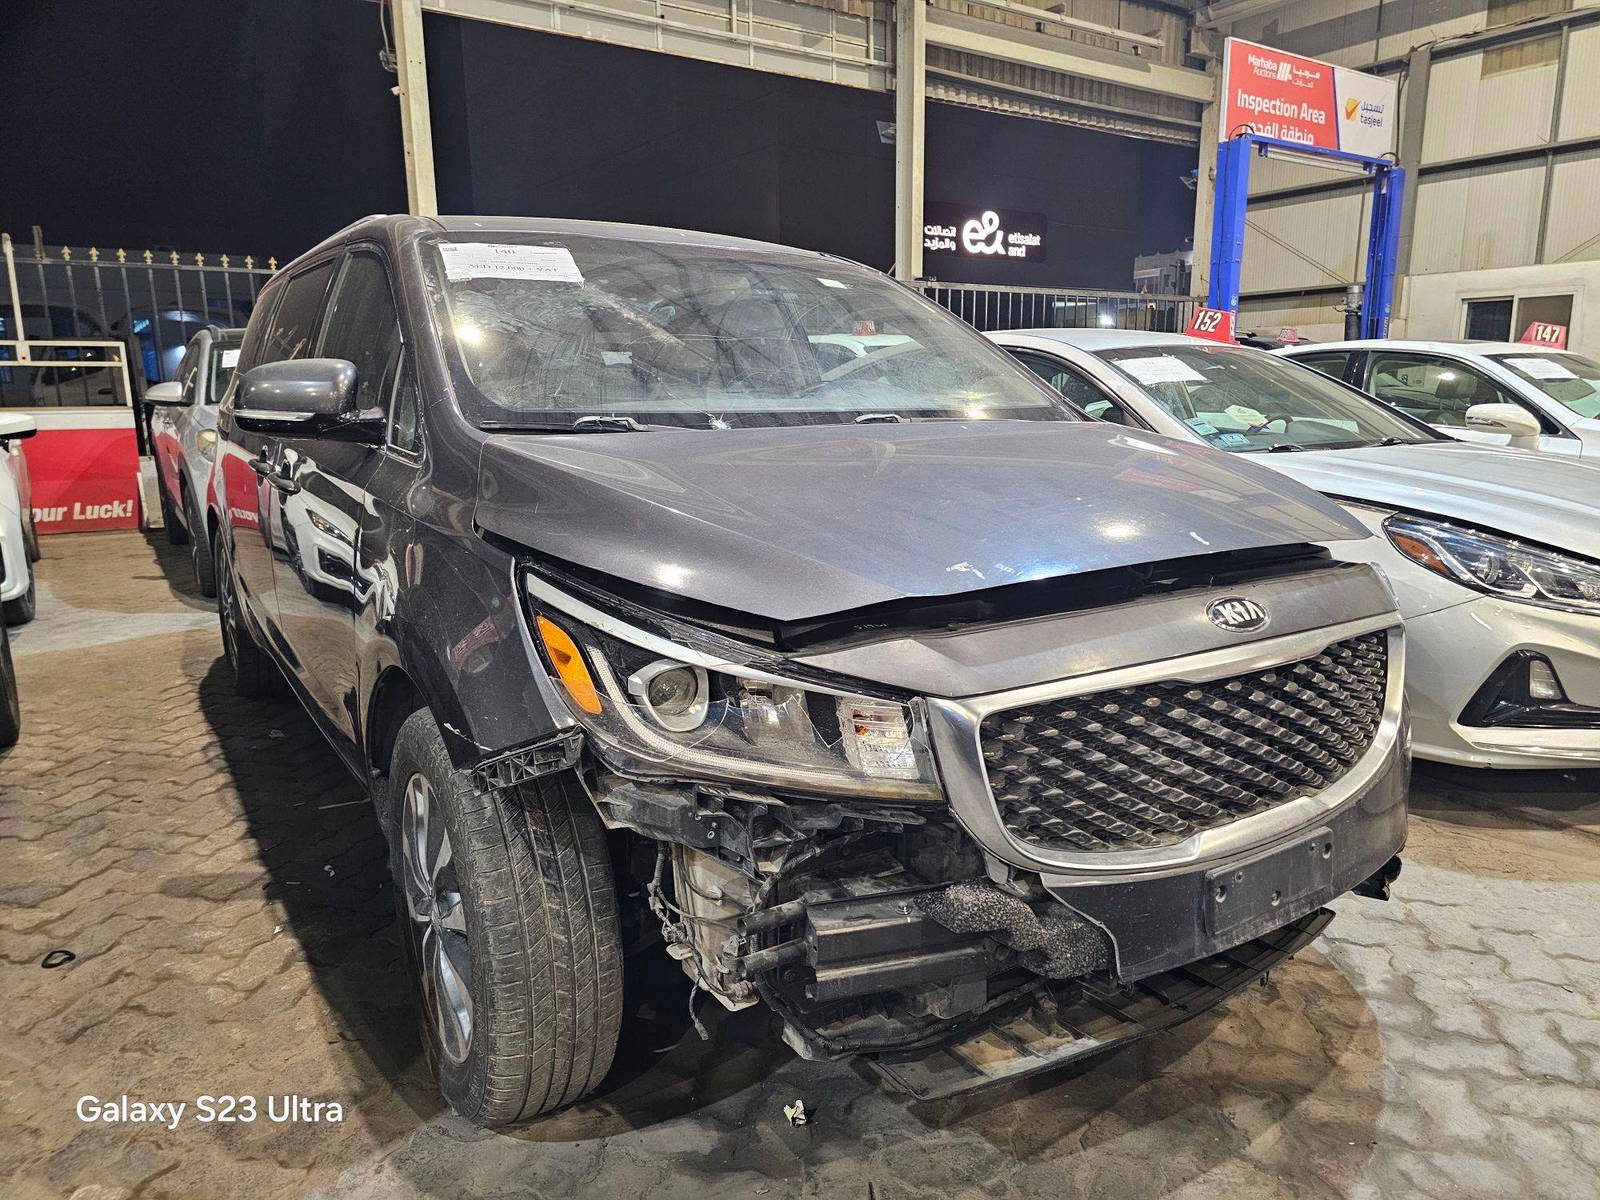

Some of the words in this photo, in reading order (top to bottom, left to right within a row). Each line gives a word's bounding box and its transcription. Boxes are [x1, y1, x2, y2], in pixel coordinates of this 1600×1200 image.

[1247, 53, 1277, 71] Marhaba
[1237, 88, 1298, 118] Inspection
[1299, 102, 1325, 125] Area
[1360, 113, 1383, 128] tasjeel
[1008, 232, 1041, 246] etisalat
[1008, 245, 1026, 257] and
[1194, 310, 1222, 333] 152
[1536, 325, 1560, 343] 147
[32, 506, 67, 523] our
[73, 500, 133, 520] Luck!
[1214, 600, 1265, 625] KIA
